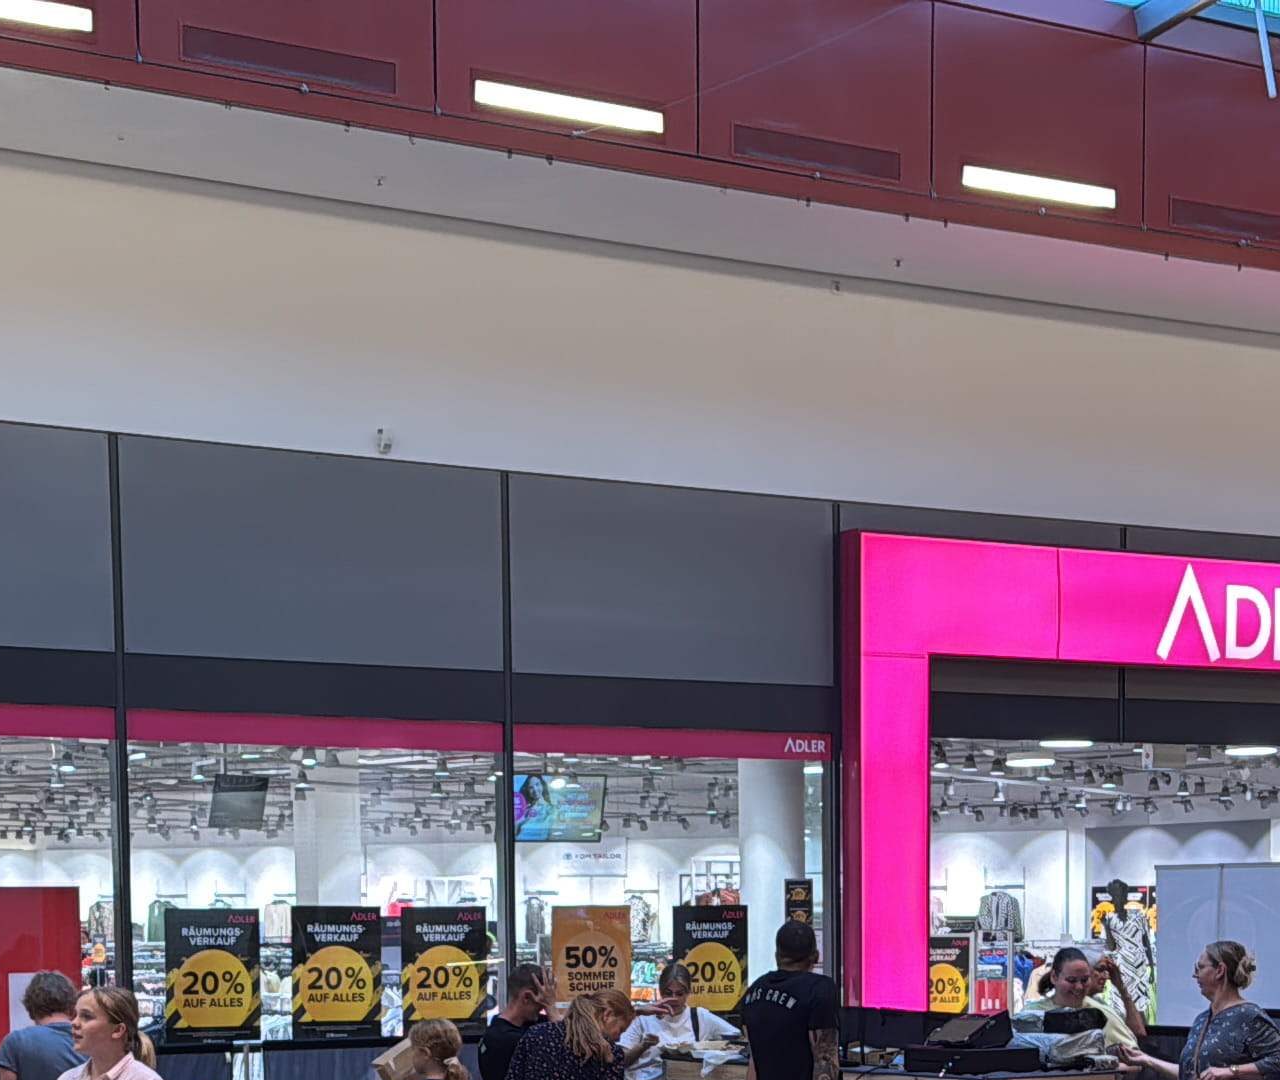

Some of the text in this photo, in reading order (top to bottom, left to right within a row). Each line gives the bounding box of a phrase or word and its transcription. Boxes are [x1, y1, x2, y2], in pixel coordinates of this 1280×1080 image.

[783, 736, 826, 753] ADLER
[181, 926, 245, 938] RÄUMUNGS-
[306, 922, 367, 934] RÄUMUNGS-
[415, 922, 473, 934] RÄUMUNGS-
[314, 932, 360, 943] VERKAUF
[422, 932, 466, 943] VERKAUF
[691, 930, 730, 939] VERKAUF
[189, 936, 238, 947] VERKAUF
[564, 944, 619, 969] 50%
[415, 964, 474, 990] 20%
[567, 970, 617, 982] SOMMER
[686, 960, 737, 984] 20%
[181, 970, 246, 997] 20%
[307, 966, 368, 992] 20%
[706, 984, 736, 994] ALLES
[307, 991, 366, 1004] AUF ALLES
[416, 990, 473, 1002] AUF ALLES
[182, 997, 244, 1009] AUF ALLES
